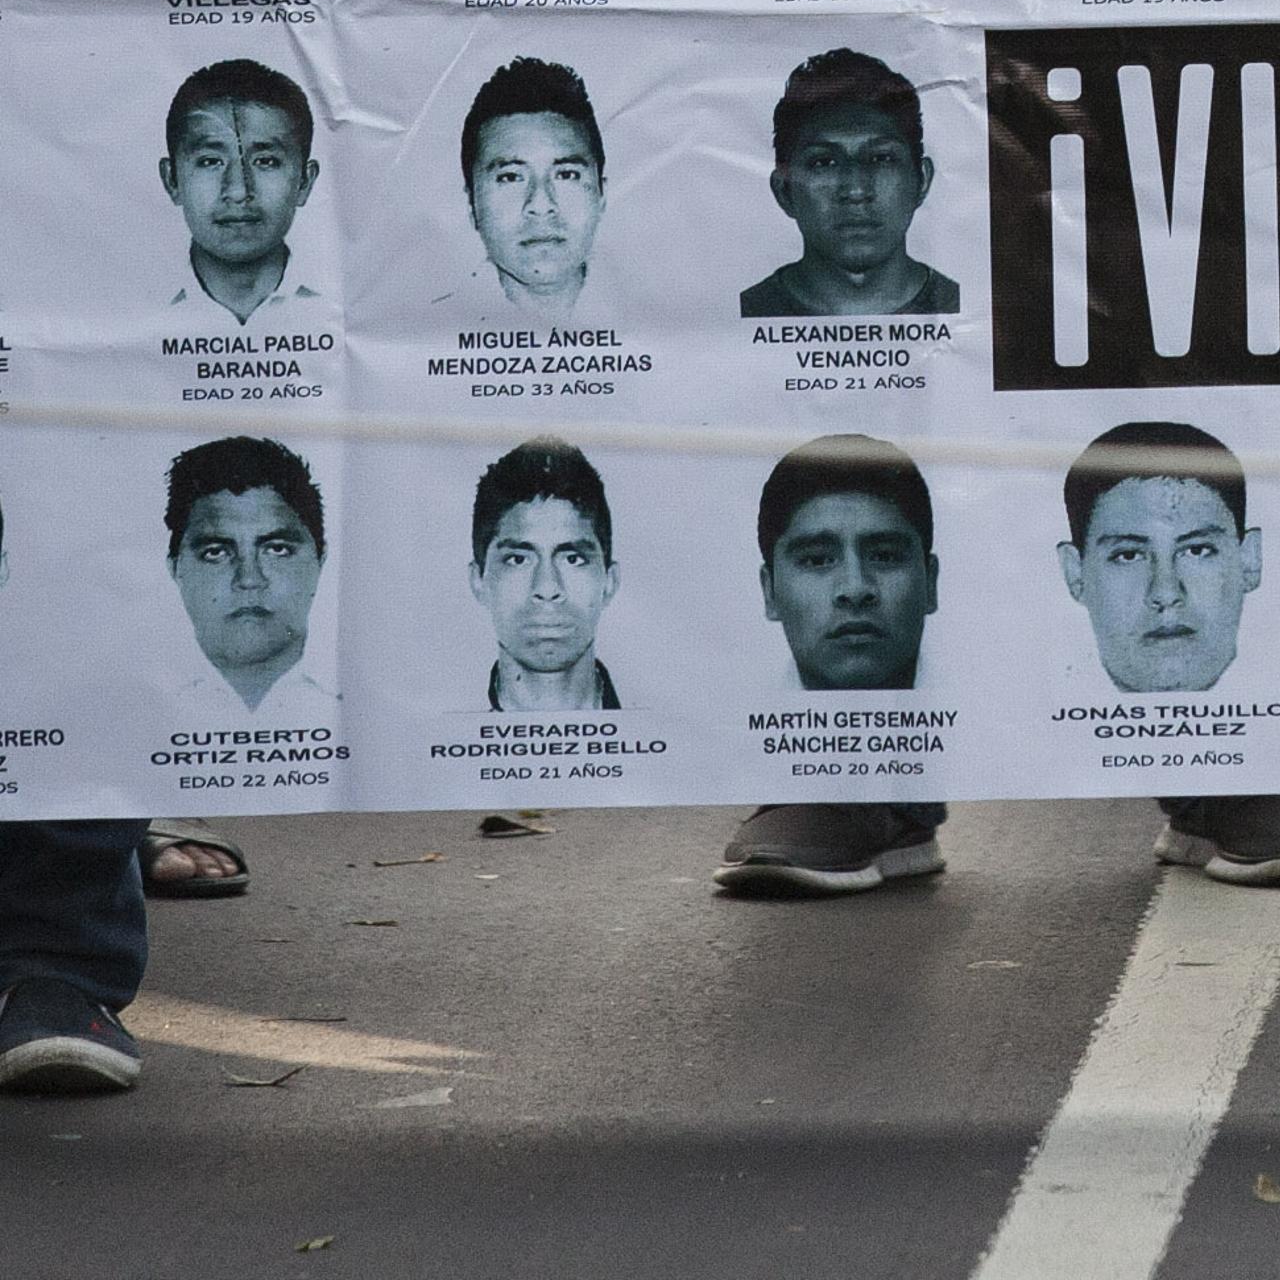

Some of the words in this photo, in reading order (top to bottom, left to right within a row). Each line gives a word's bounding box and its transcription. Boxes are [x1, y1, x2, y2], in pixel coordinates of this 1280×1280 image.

[459, 331, 542, 350] MIGUEL
[548, 327, 623, 348] ÁNGEL
[753, 325, 883, 344] ALEXANDER
[889, 324, 952, 342] MORA
[163, 337, 259, 355] MARCIAL
[265, 334, 334, 353] PABLO
[428, 357, 537, 376] MENDOZA
[542, 355, 653, 374] ZACARIAS
[797, 350, 911, 369] VENANCIO
[198, 360, 302, 380] BARANDA
[786, 378, 839, 391] EDAD
[846, 378, 867, 390] 21
[874, 374, 926, 390] AÑOS
[749, 709, 828, 730] MARTÍN
[834, 711, 958, 729] GETSEMANY
[1052, 704, 1146, 722] JONÁS
[0, 729, 65, 746] RERO
[171, 728, 332, 747] CUTBERTO
[480, 723, 618, 739] EVERARDO
[1095, 721, 1246, 739] GONZÁLEZ
[431, 742, 580, 759] RODRIGUEZ
[588, 741, 667, 755] BELLO
[764, 734, 863, 755] SÁNCHEZ
[867, 732, 945, 753] GARCÍA
[151, 751, 238, 766] ORTIZ
[247, 747, 350, 764] RAMOS
